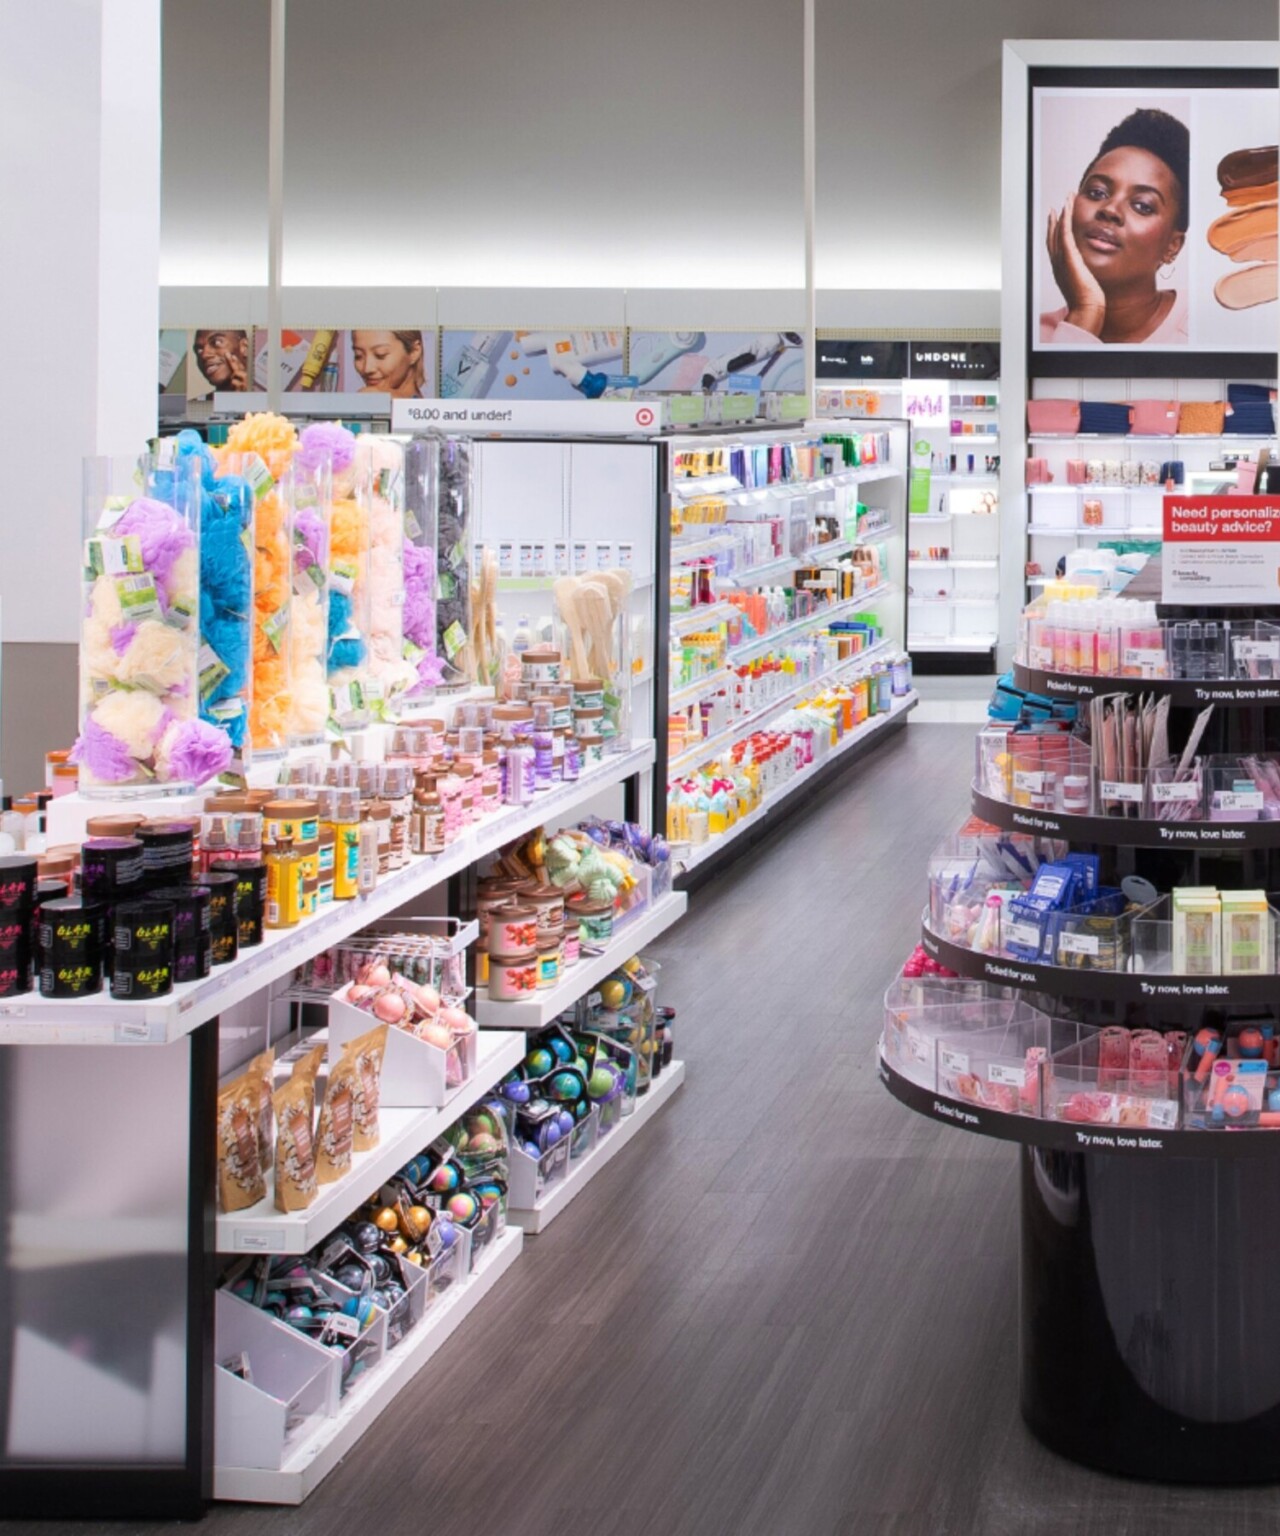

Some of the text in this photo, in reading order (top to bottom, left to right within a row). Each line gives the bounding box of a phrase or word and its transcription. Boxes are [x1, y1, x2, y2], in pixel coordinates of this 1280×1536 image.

[915, 352, 967, 363] UNDONE
[408, 407, 513, 422] $8.00 and under!
[1171, 506, 1207, 519] Need
[1171, 520, 1272, 535] beauty advice?
[1195, 688, 1210, 700] Try
[1212, 689, 1235, 699] now,
[1236, 688, 1256, 698] love
[1160, 827, 1174, 840] Try
[1175, 830, 1198, 840] now,
[1200, 829, 1221, 839] love
[1140, 982, 1156, 994] Try
[1158, 984, 1181, 995] now,
[1182, 983, 1203, 994] love
[1076, 1131, 1092, 1145] Try
[1093, 1135, 1115, 1148] now,
[1117, 1135, 1137, 1148] love
